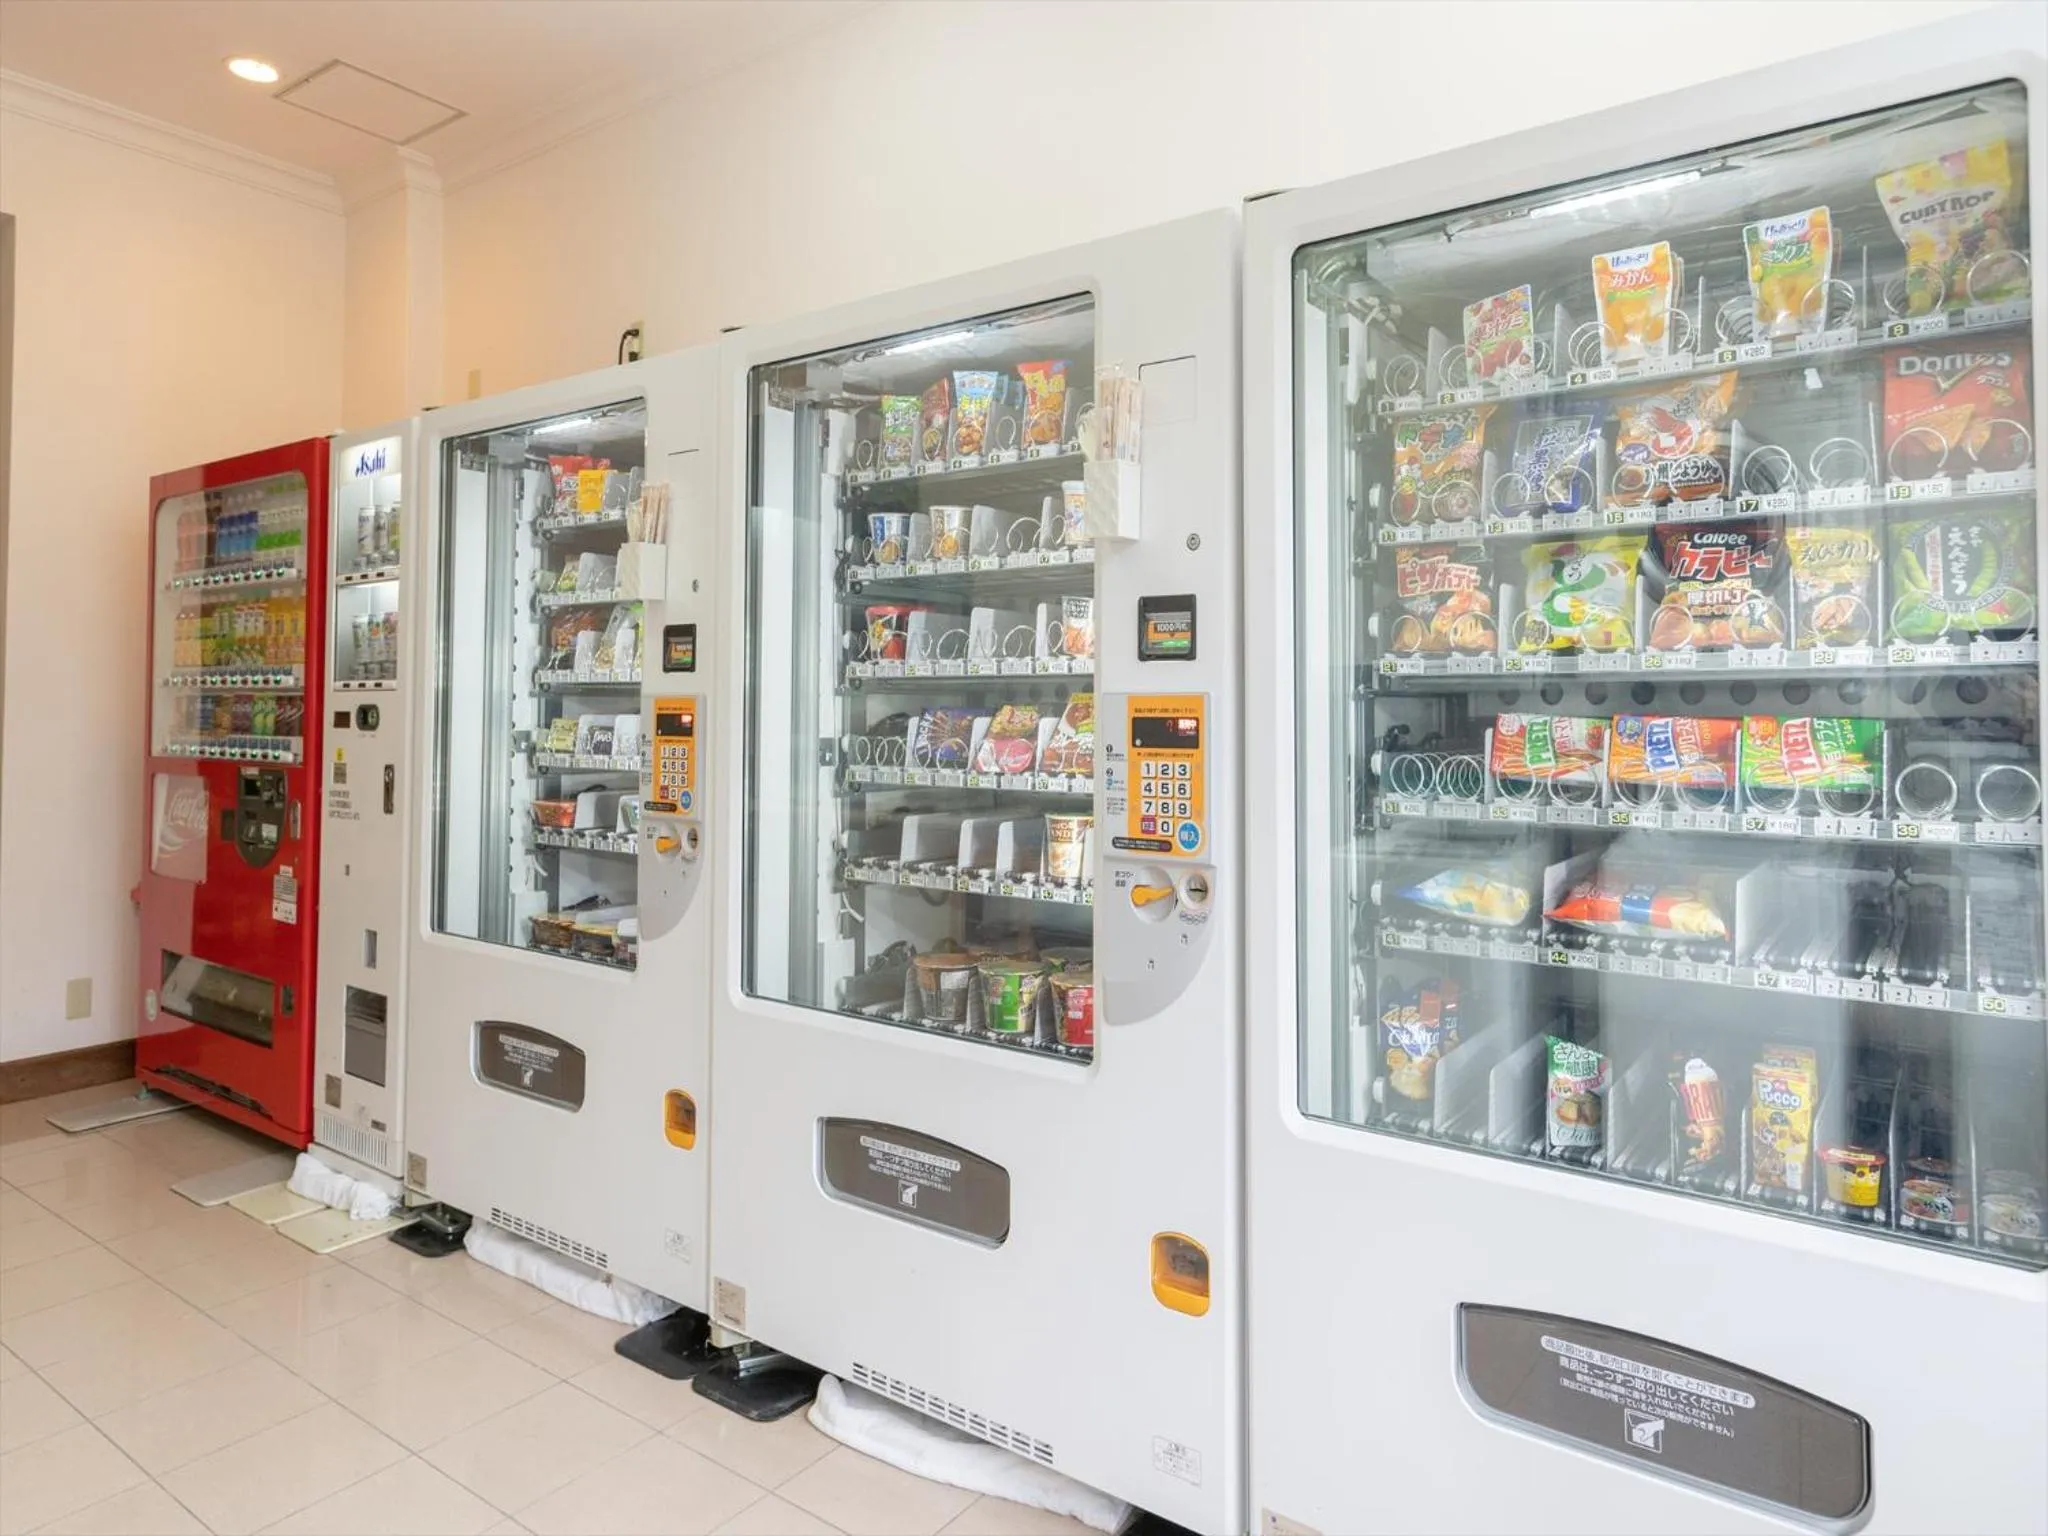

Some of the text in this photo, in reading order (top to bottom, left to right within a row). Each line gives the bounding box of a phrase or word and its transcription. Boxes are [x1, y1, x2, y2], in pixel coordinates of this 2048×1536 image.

[1740, 499, 1757, 511] 17
[1669, 541, 1774, 581] カラビー
[1527, 719, 1554, 764] PRETZ
[1648, 719, 1677, 768] PRETZ
[1784, 719, 1818, 773] PRETZ
[681, 747, 687, 757] 3
[1161, 764, 1170, 775] 2
[1178, 764, 1187, 776] 3
[1143, 782, 1187, 796] 4 5 6
[1144, 802, 1187, 815] 7 8 9
[1161, 821, 1170, 833] 0
[1746, 819, 1765, 830] 37
[1551, 952, 1569, 963] 44
